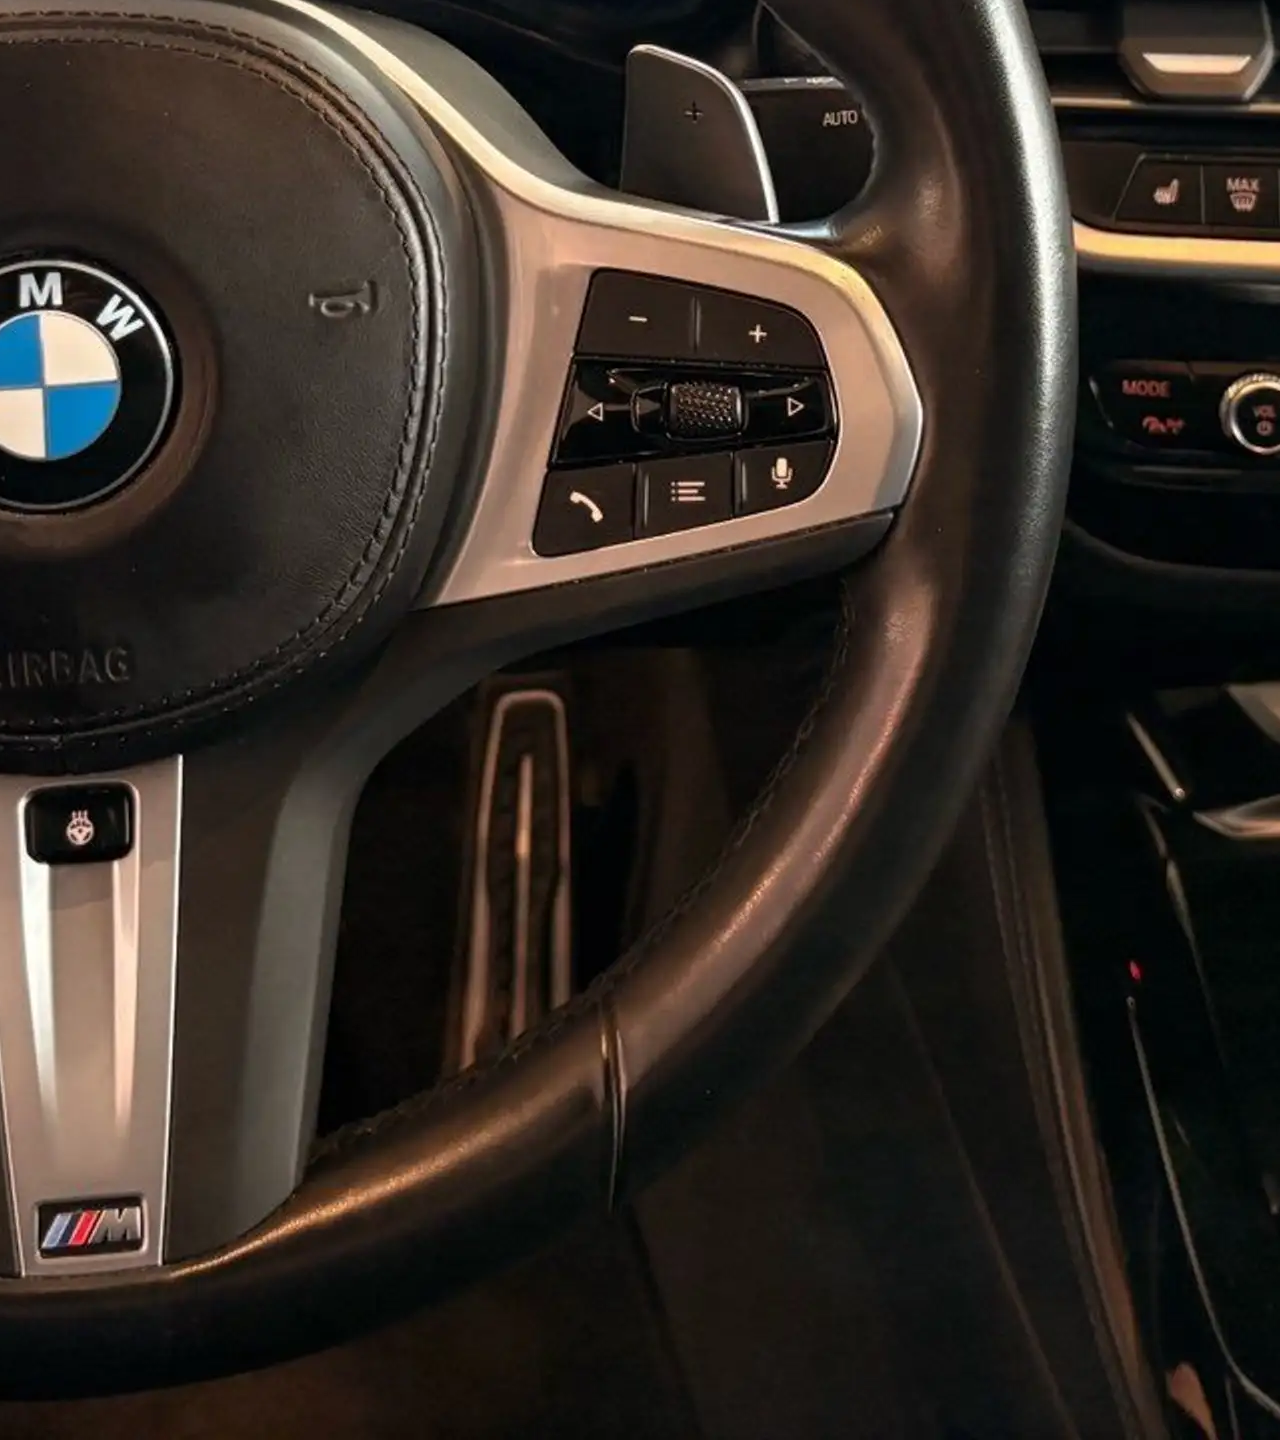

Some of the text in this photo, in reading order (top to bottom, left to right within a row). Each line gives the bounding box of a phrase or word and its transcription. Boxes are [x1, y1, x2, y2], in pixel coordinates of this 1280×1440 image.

[822, 110, 859, 127] AUTO
[1226, 177, 1260, 193] MAX
[1122, 378, 1170, 398] MODE
